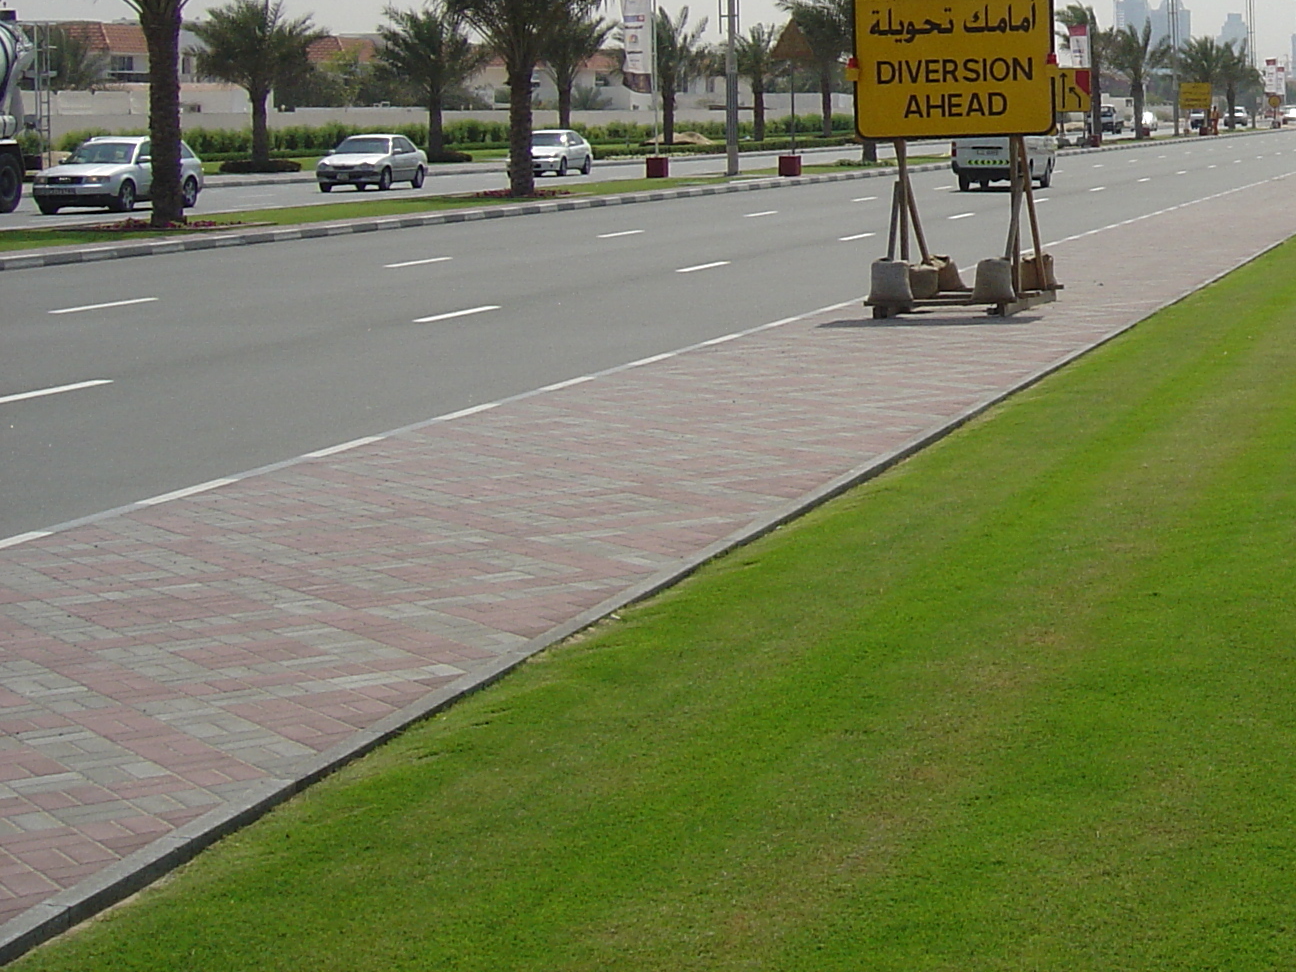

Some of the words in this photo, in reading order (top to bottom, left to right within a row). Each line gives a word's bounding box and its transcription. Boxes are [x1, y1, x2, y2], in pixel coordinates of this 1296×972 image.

[869, 7, 955, 44] تحويلة
[876, 57, 1033, 85] DIVERSION
[904, 92, 1008, 119] AHEAD
